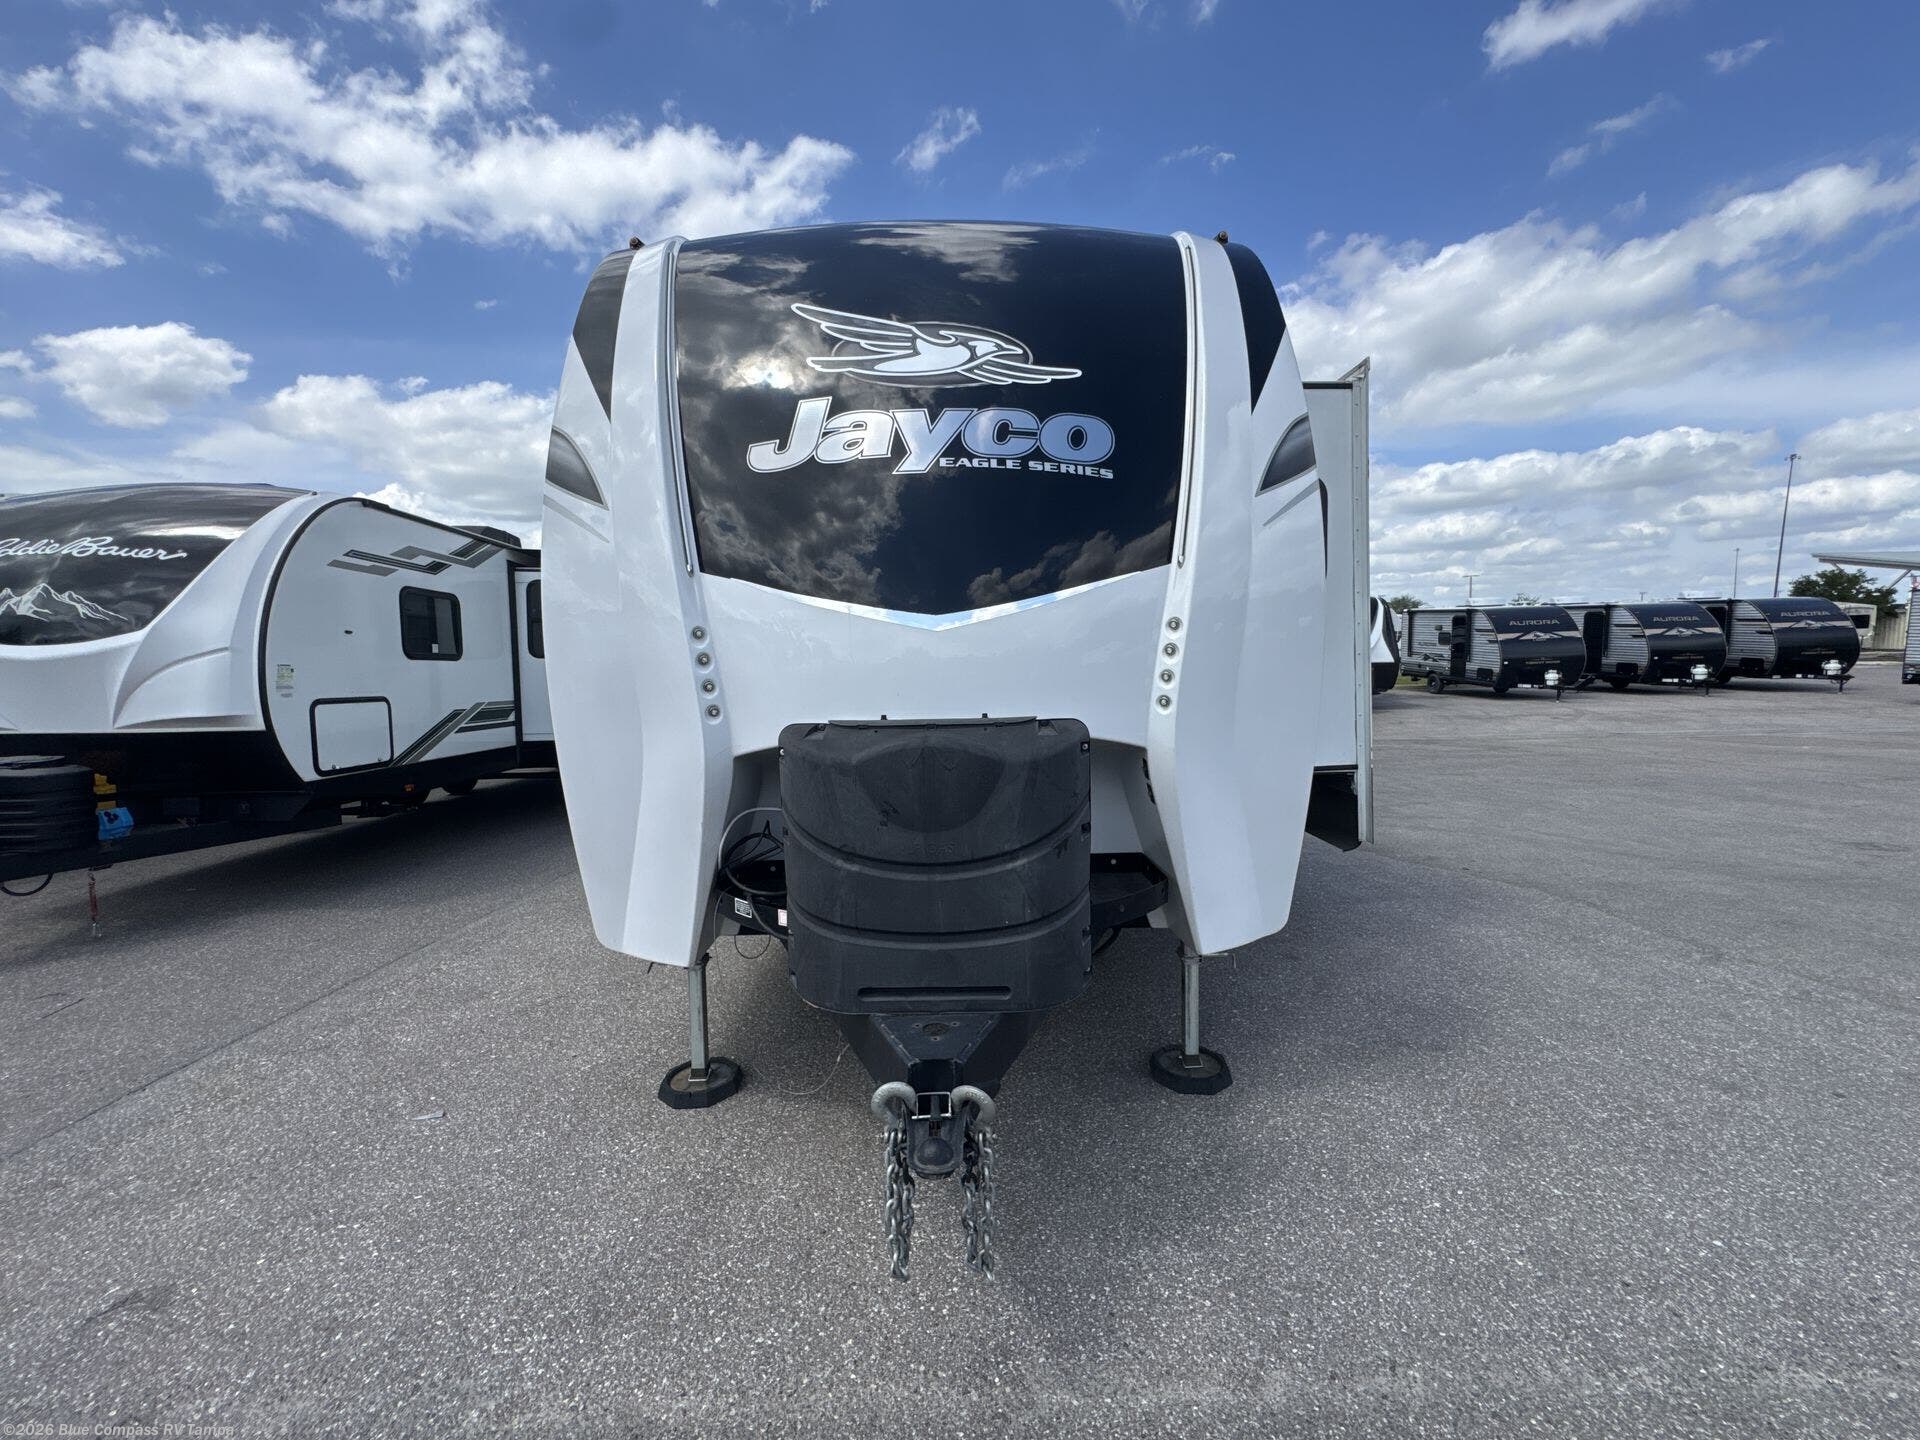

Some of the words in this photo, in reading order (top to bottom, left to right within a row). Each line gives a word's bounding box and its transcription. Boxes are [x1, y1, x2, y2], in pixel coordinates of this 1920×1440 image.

[746, 396, 1116, 475] Jayco
[939, 457, 1022, 469] EAGLE
[1029, 459, 1114, 479] SERIES
[61, 536, 187, 560] Bauer
